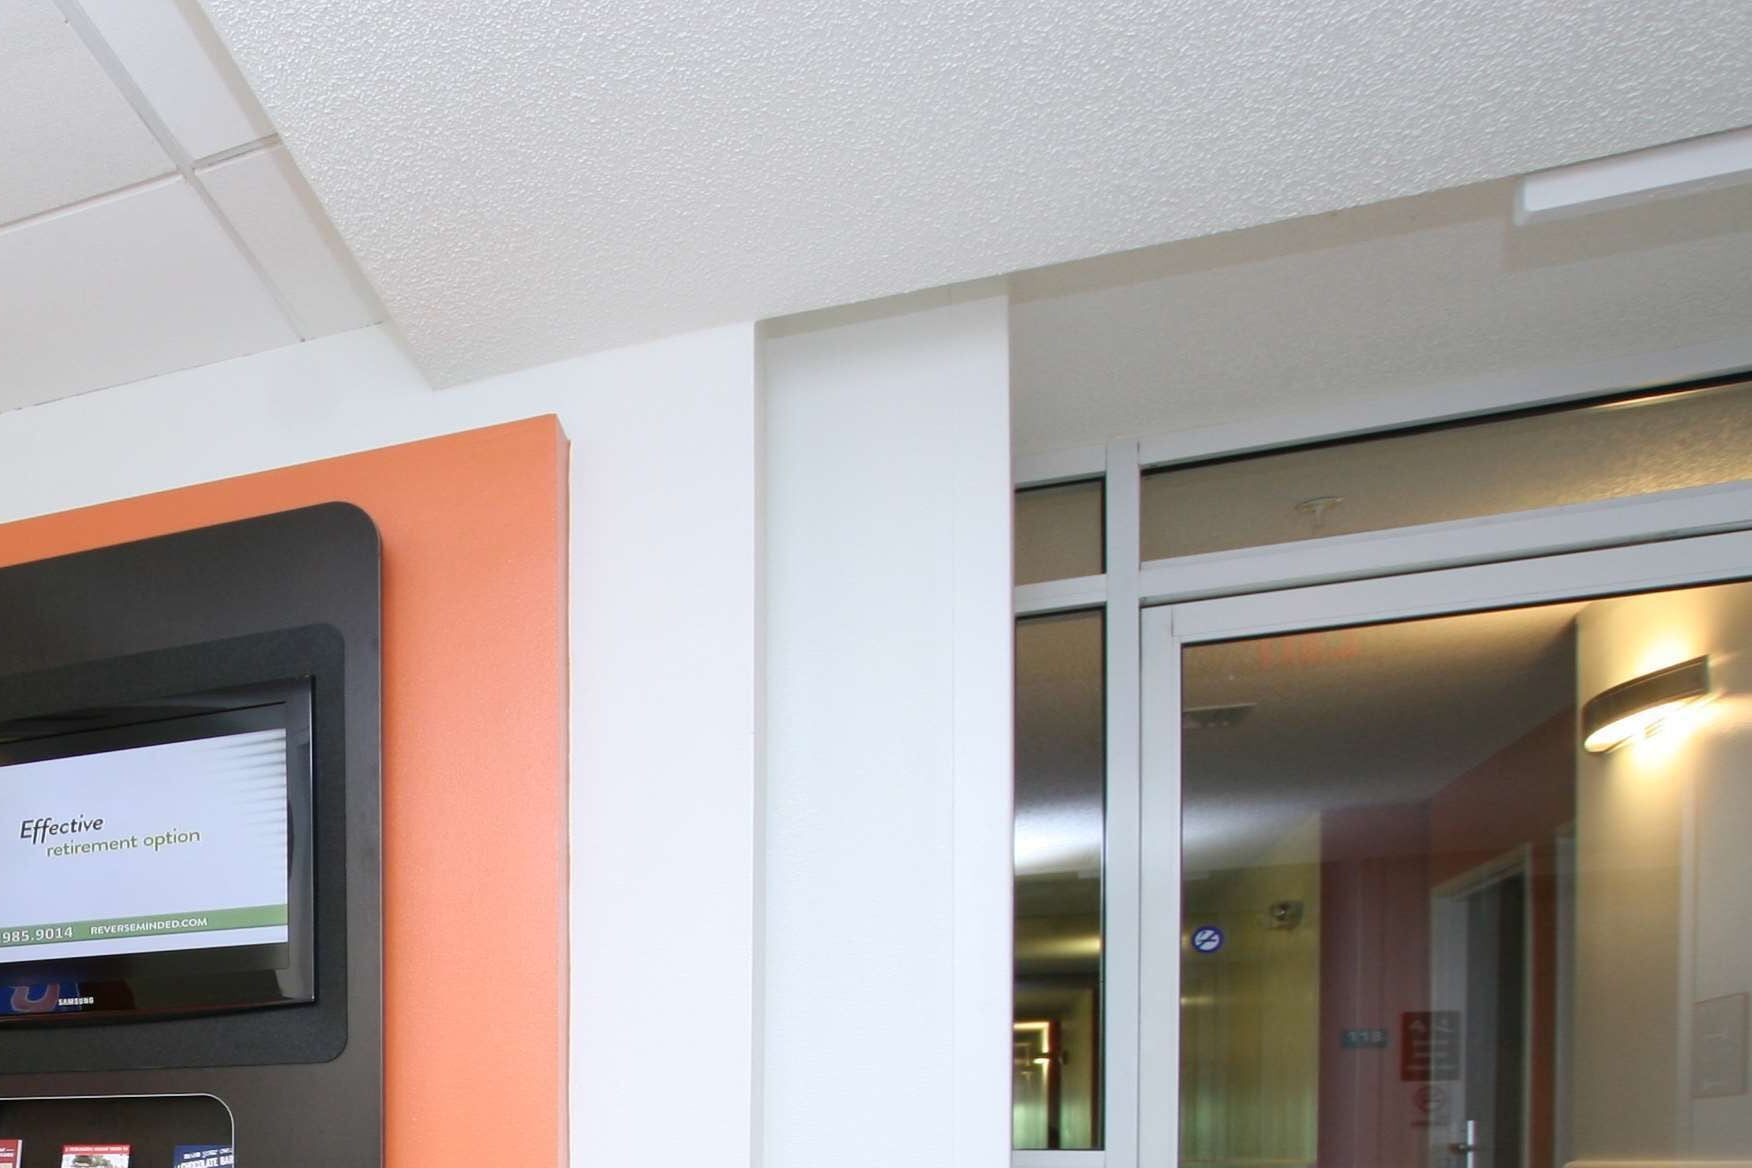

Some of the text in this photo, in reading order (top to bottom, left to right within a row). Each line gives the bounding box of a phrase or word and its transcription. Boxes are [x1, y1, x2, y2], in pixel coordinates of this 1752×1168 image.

[21, 814, 104, 845] Effective
[47, 829, 200, 857] retirement option
[90, 917, 208, 936] REVERSEMINDED.COM
[58, 996, 95, 1006] SAMSUNG
